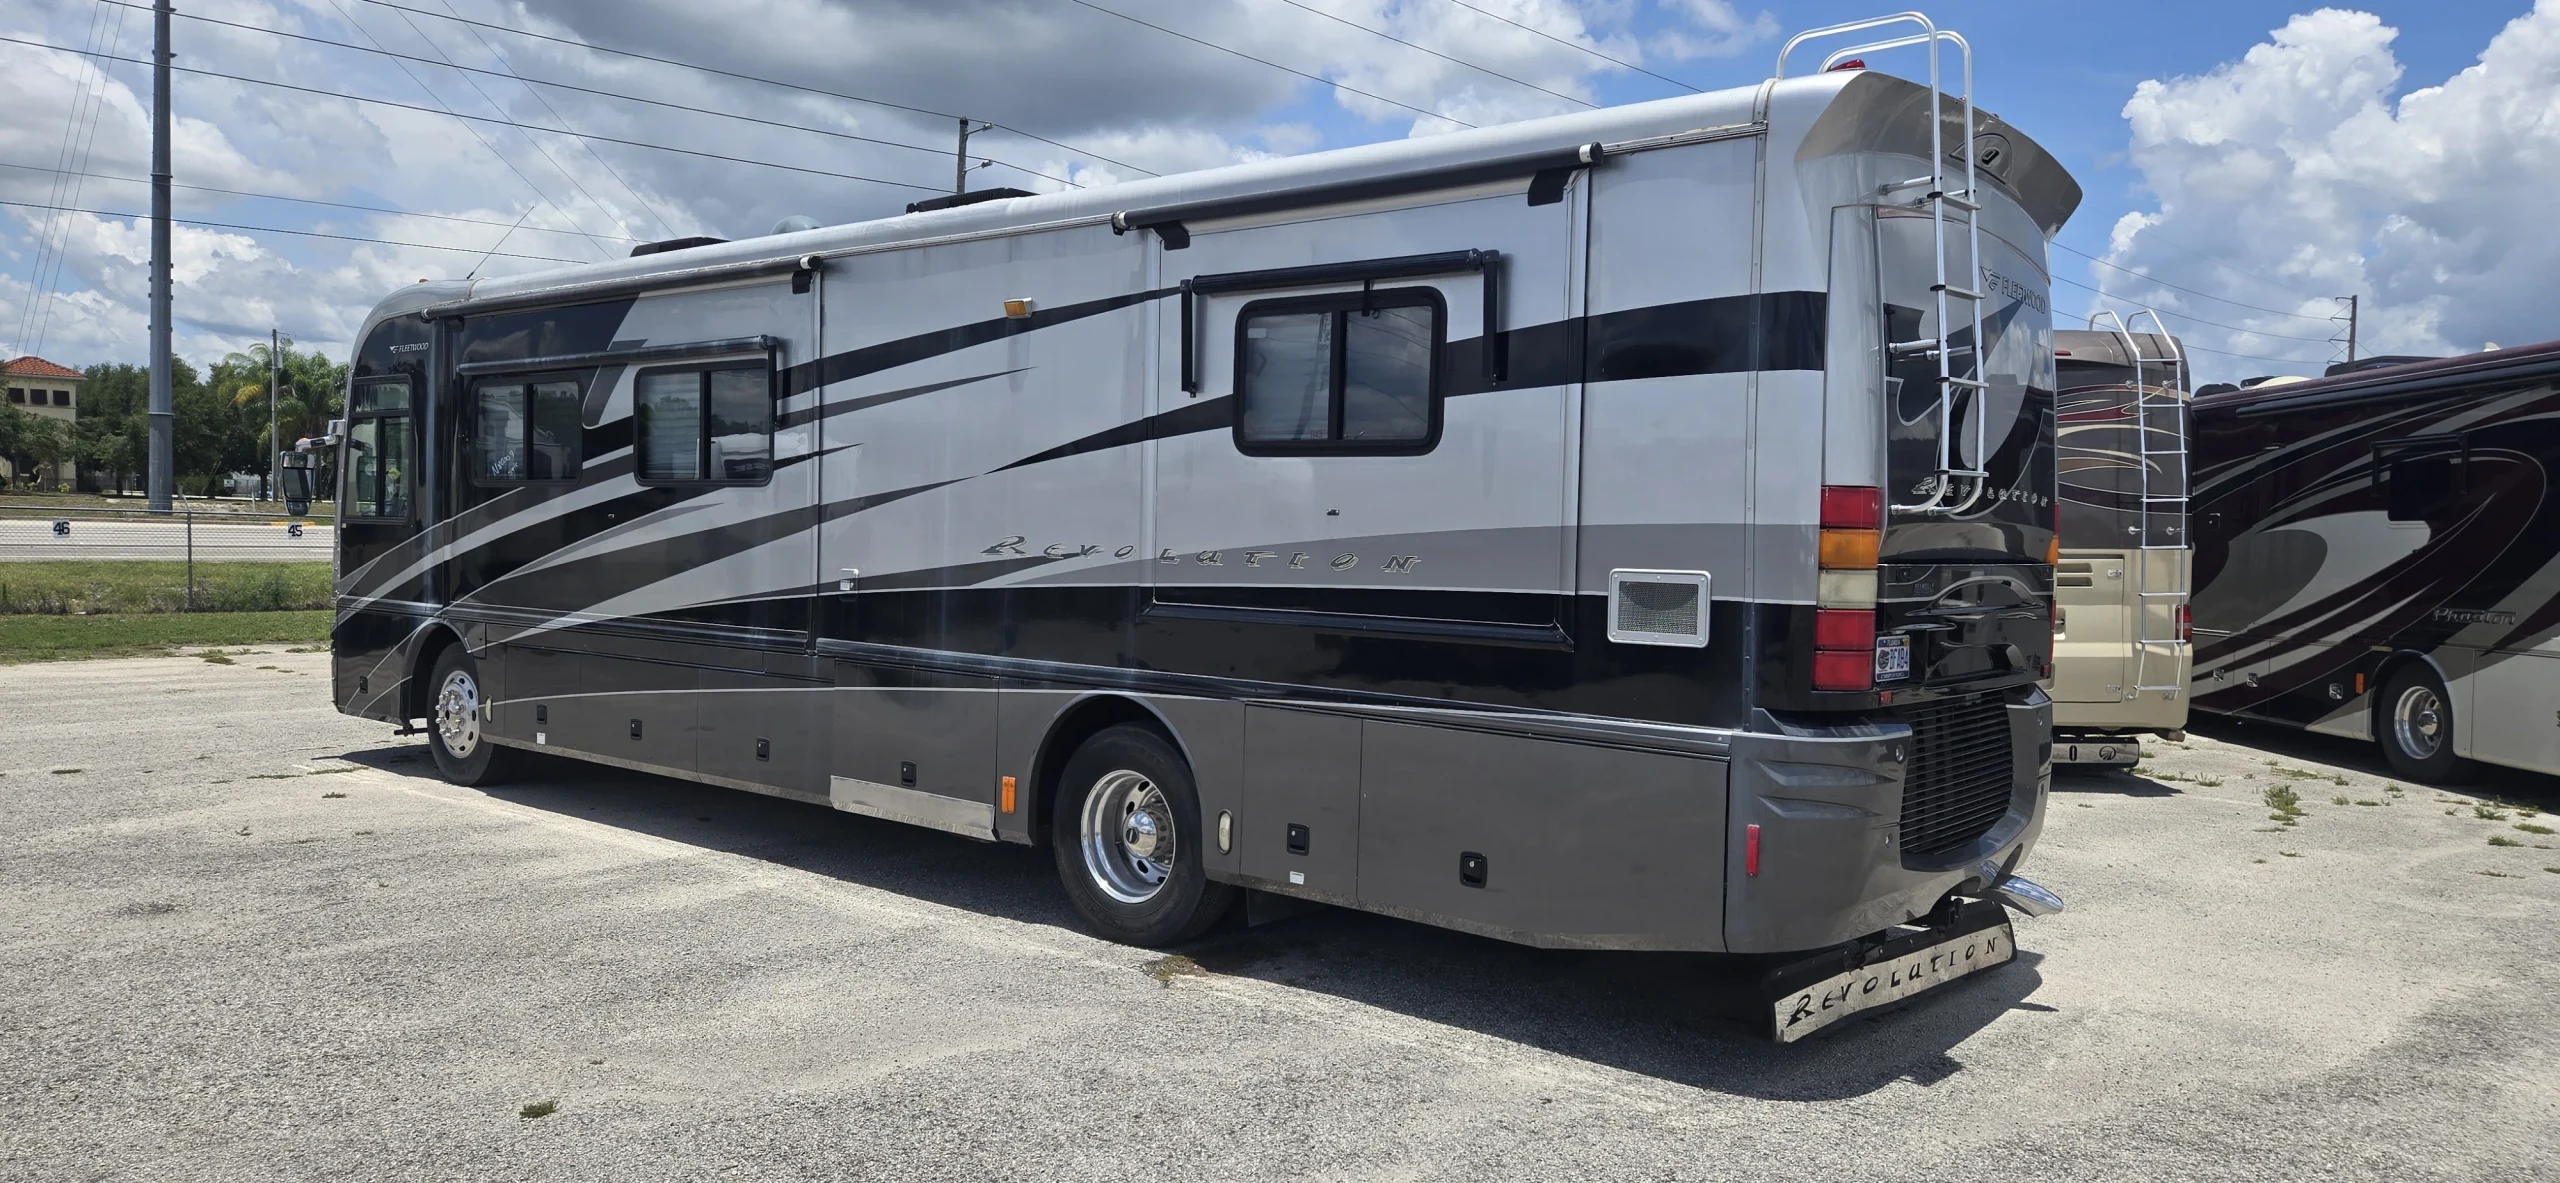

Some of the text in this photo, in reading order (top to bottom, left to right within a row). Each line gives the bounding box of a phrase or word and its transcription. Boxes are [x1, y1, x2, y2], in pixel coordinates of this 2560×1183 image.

[2001, 276, 2046, 315] FLEETWOOD
[398, 342, 429, 353] FLEETWOOD
[53, 521, 71, 536] 46
[288, 524, 303, 537] 45
[980, 534, 1422, 573] REVOLUTION
[1785, 936, 1998, 1028] REVOLUTION
